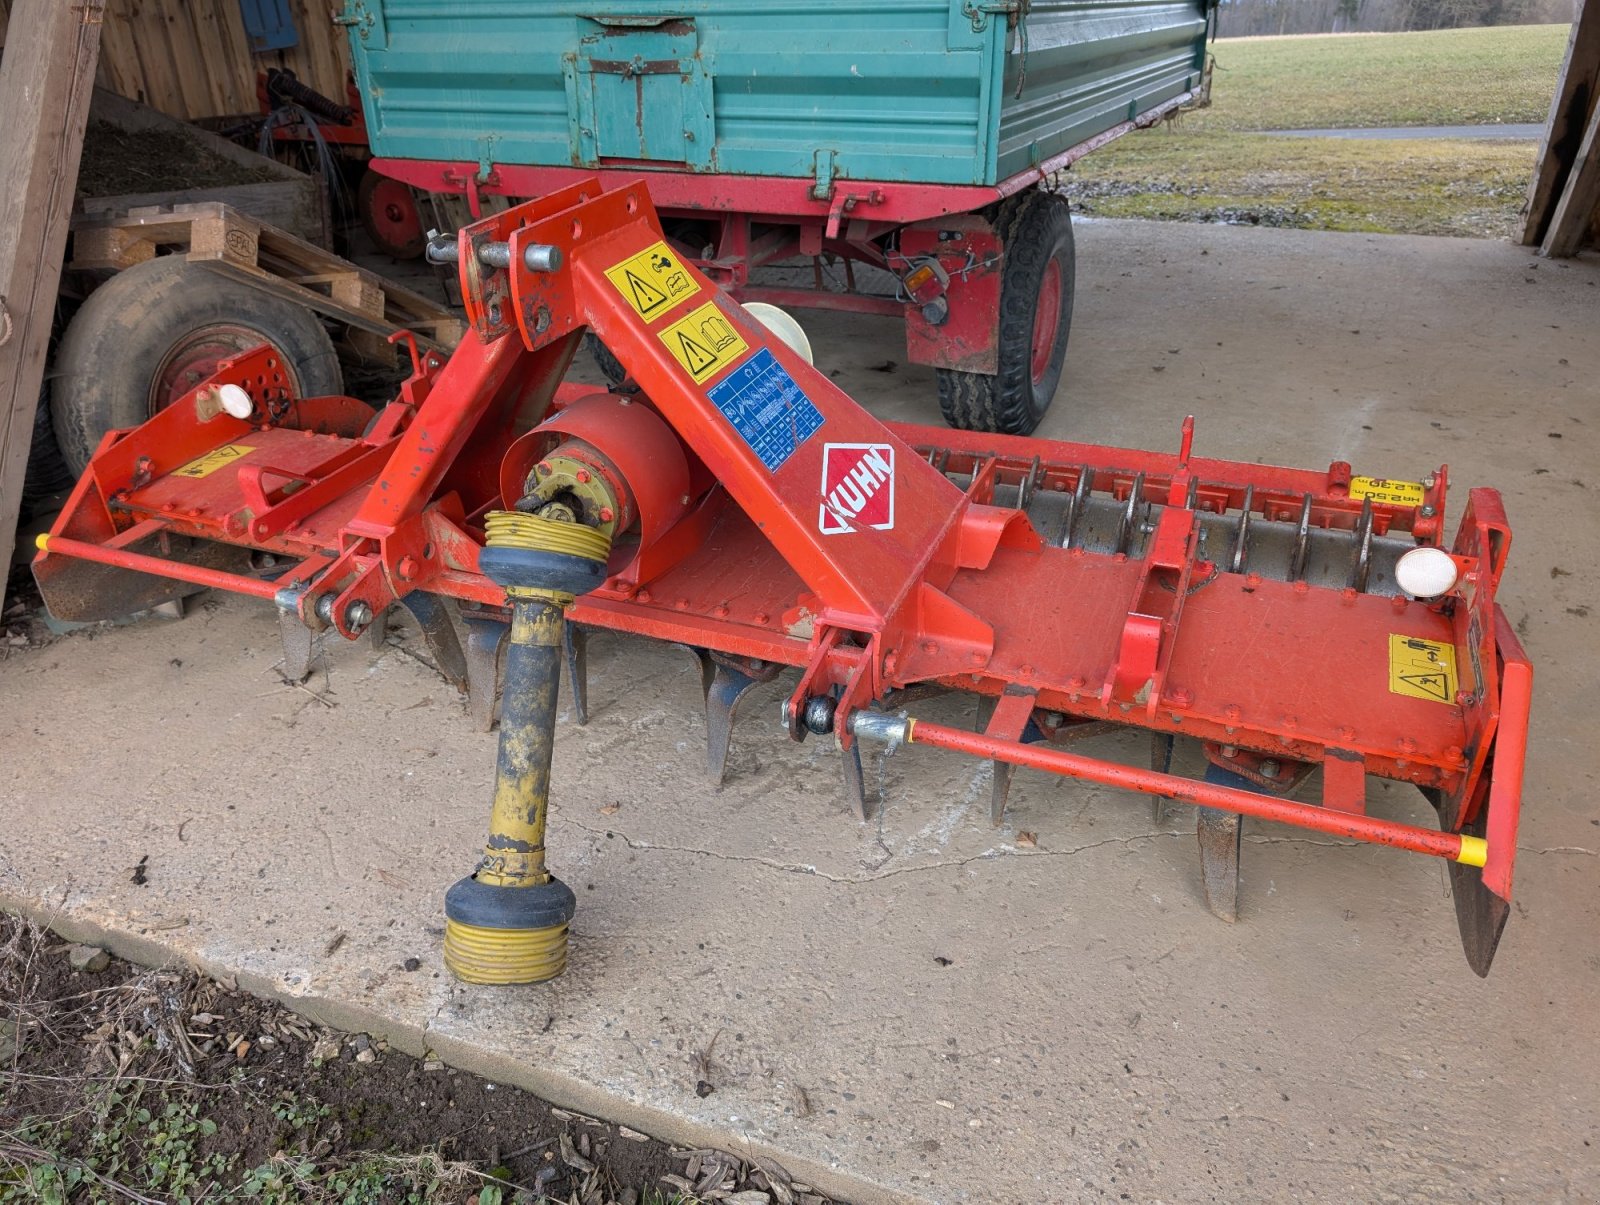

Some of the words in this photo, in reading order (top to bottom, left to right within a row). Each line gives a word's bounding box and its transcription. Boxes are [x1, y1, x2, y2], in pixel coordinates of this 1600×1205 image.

[230, 233, 252, 256] EPAL
[825, 445, 893, 531] KUHN
[1369, 480, 1405, 490] 2.30
[1365, 491, 1402, 502] 2.50
